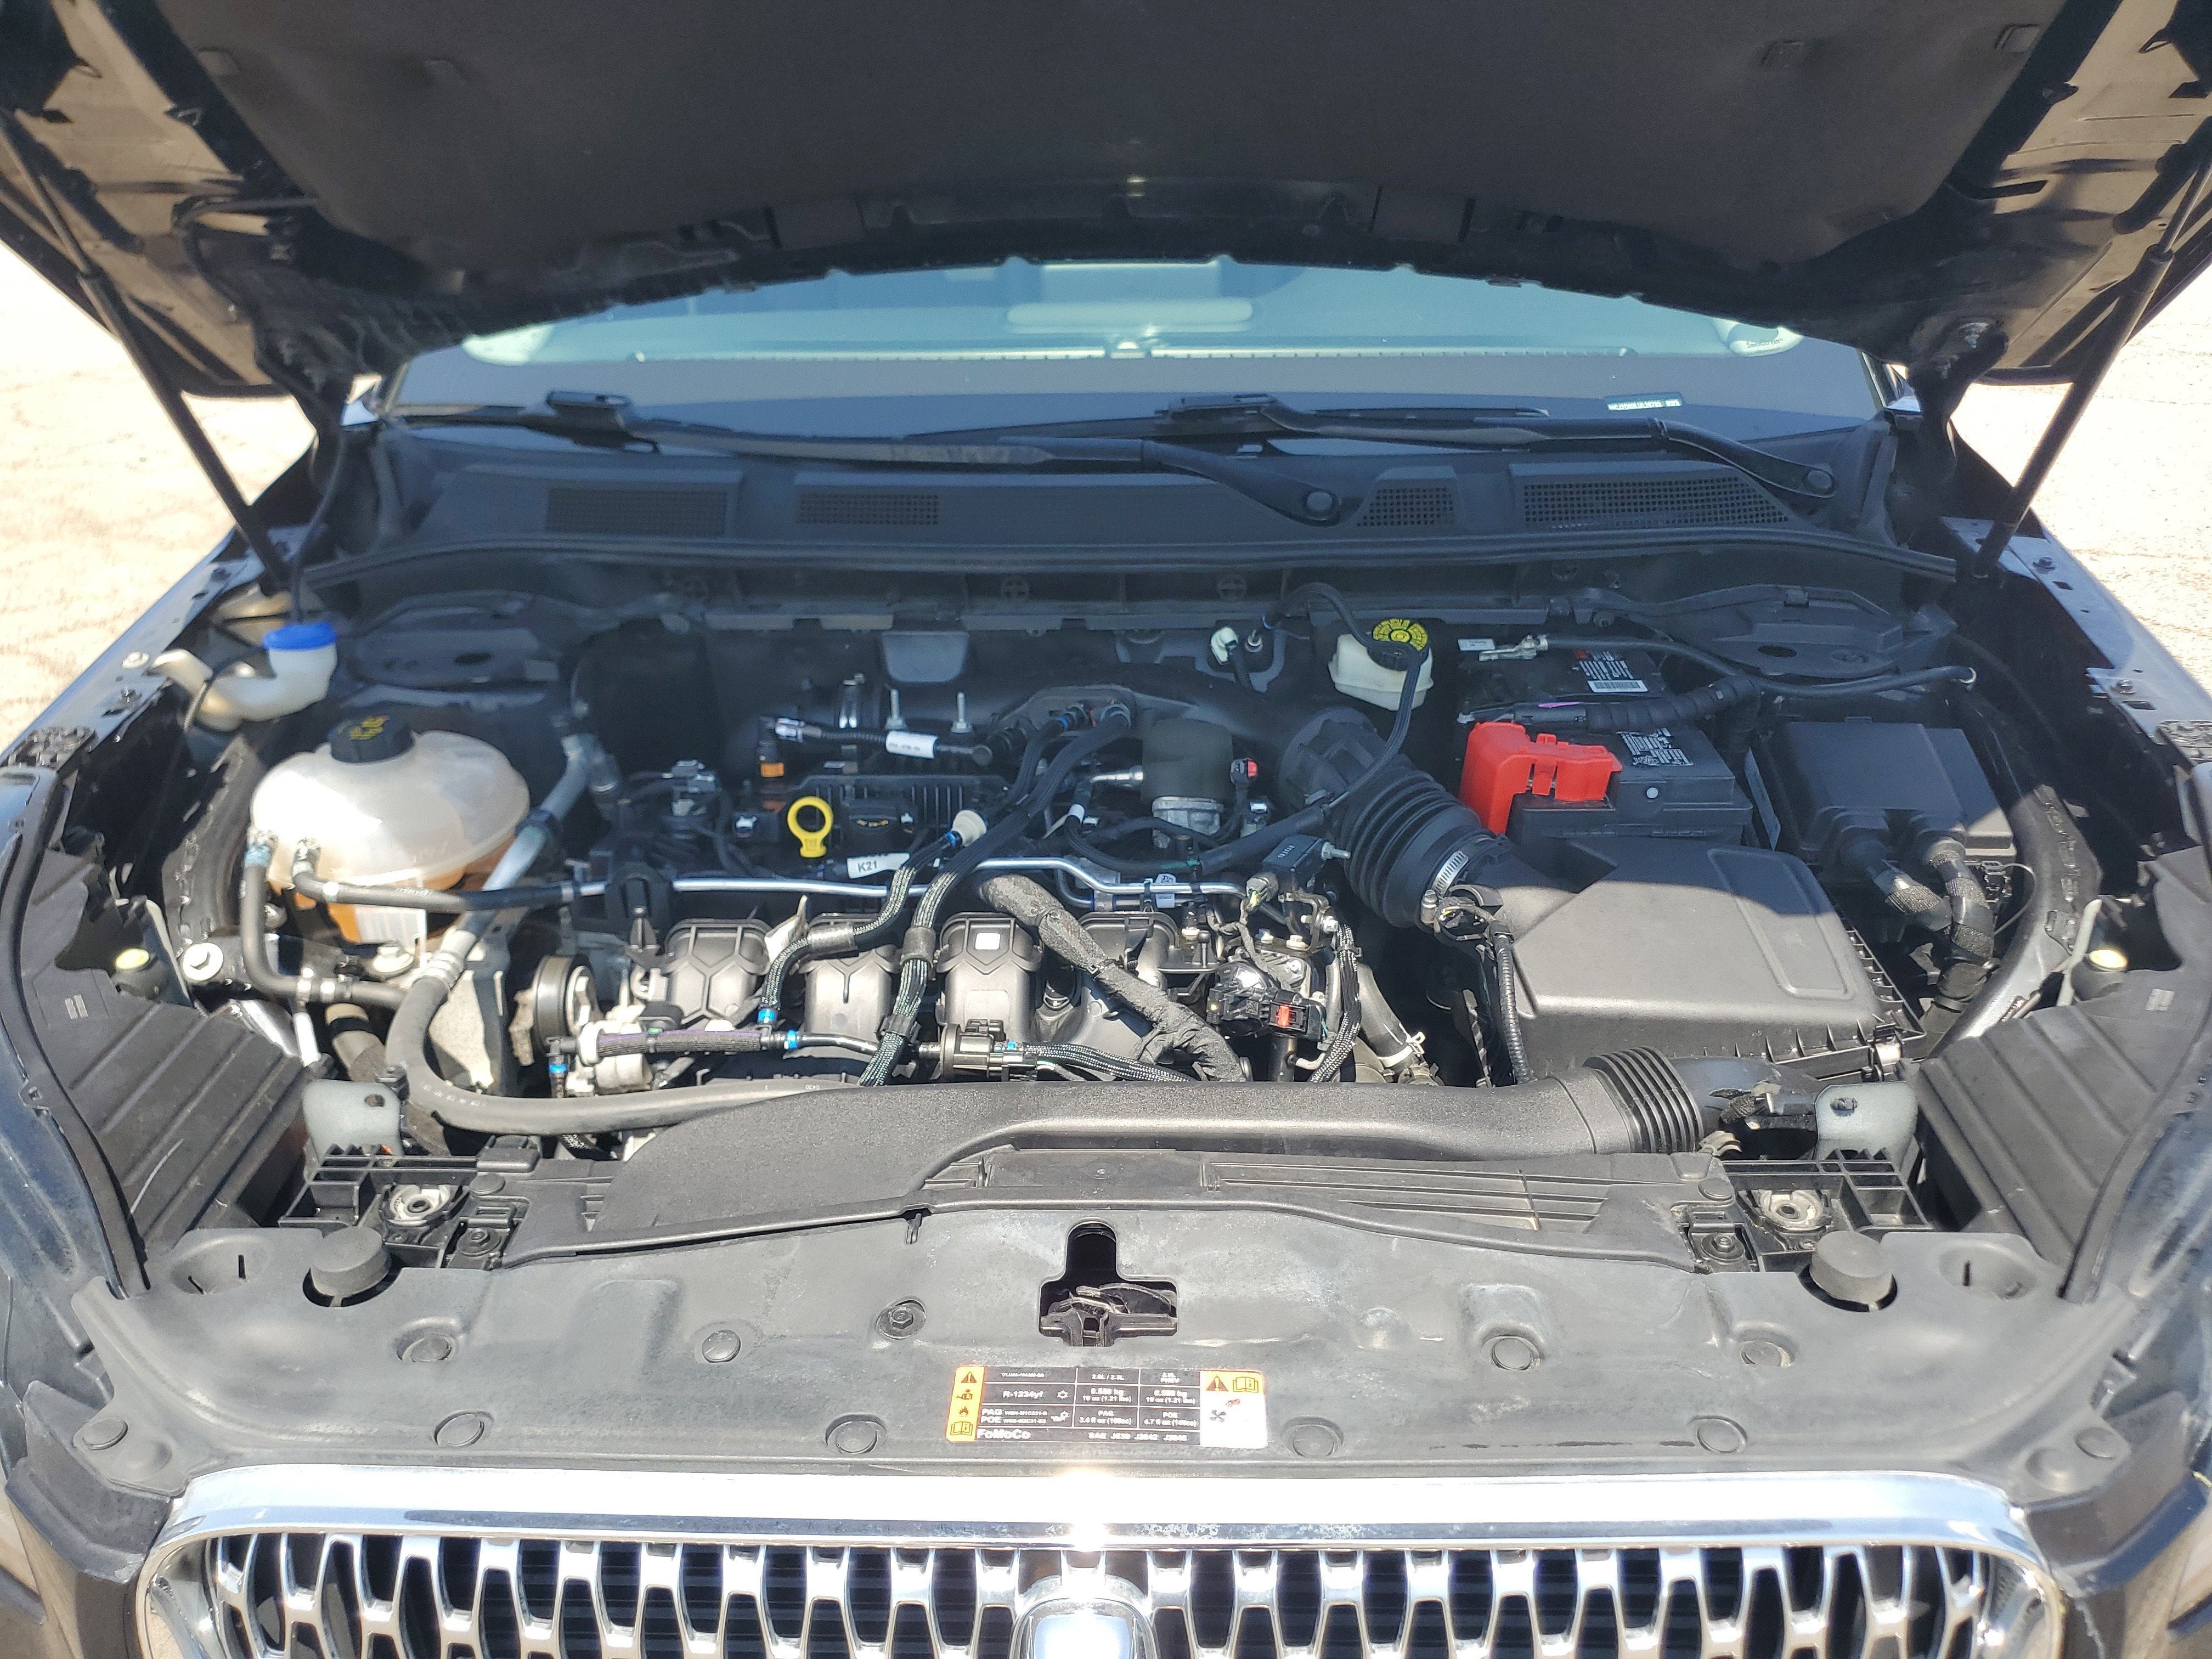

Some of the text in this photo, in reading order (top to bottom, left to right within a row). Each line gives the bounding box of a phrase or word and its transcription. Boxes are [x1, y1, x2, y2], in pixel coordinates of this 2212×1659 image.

[857, 861, 877, 873] K21
[1002, 1390, 1043, 1399] R-1234yf
[980, 1415, 1003, 1424] POE
[977, 1429, 1031, 1440] FoMoCo
